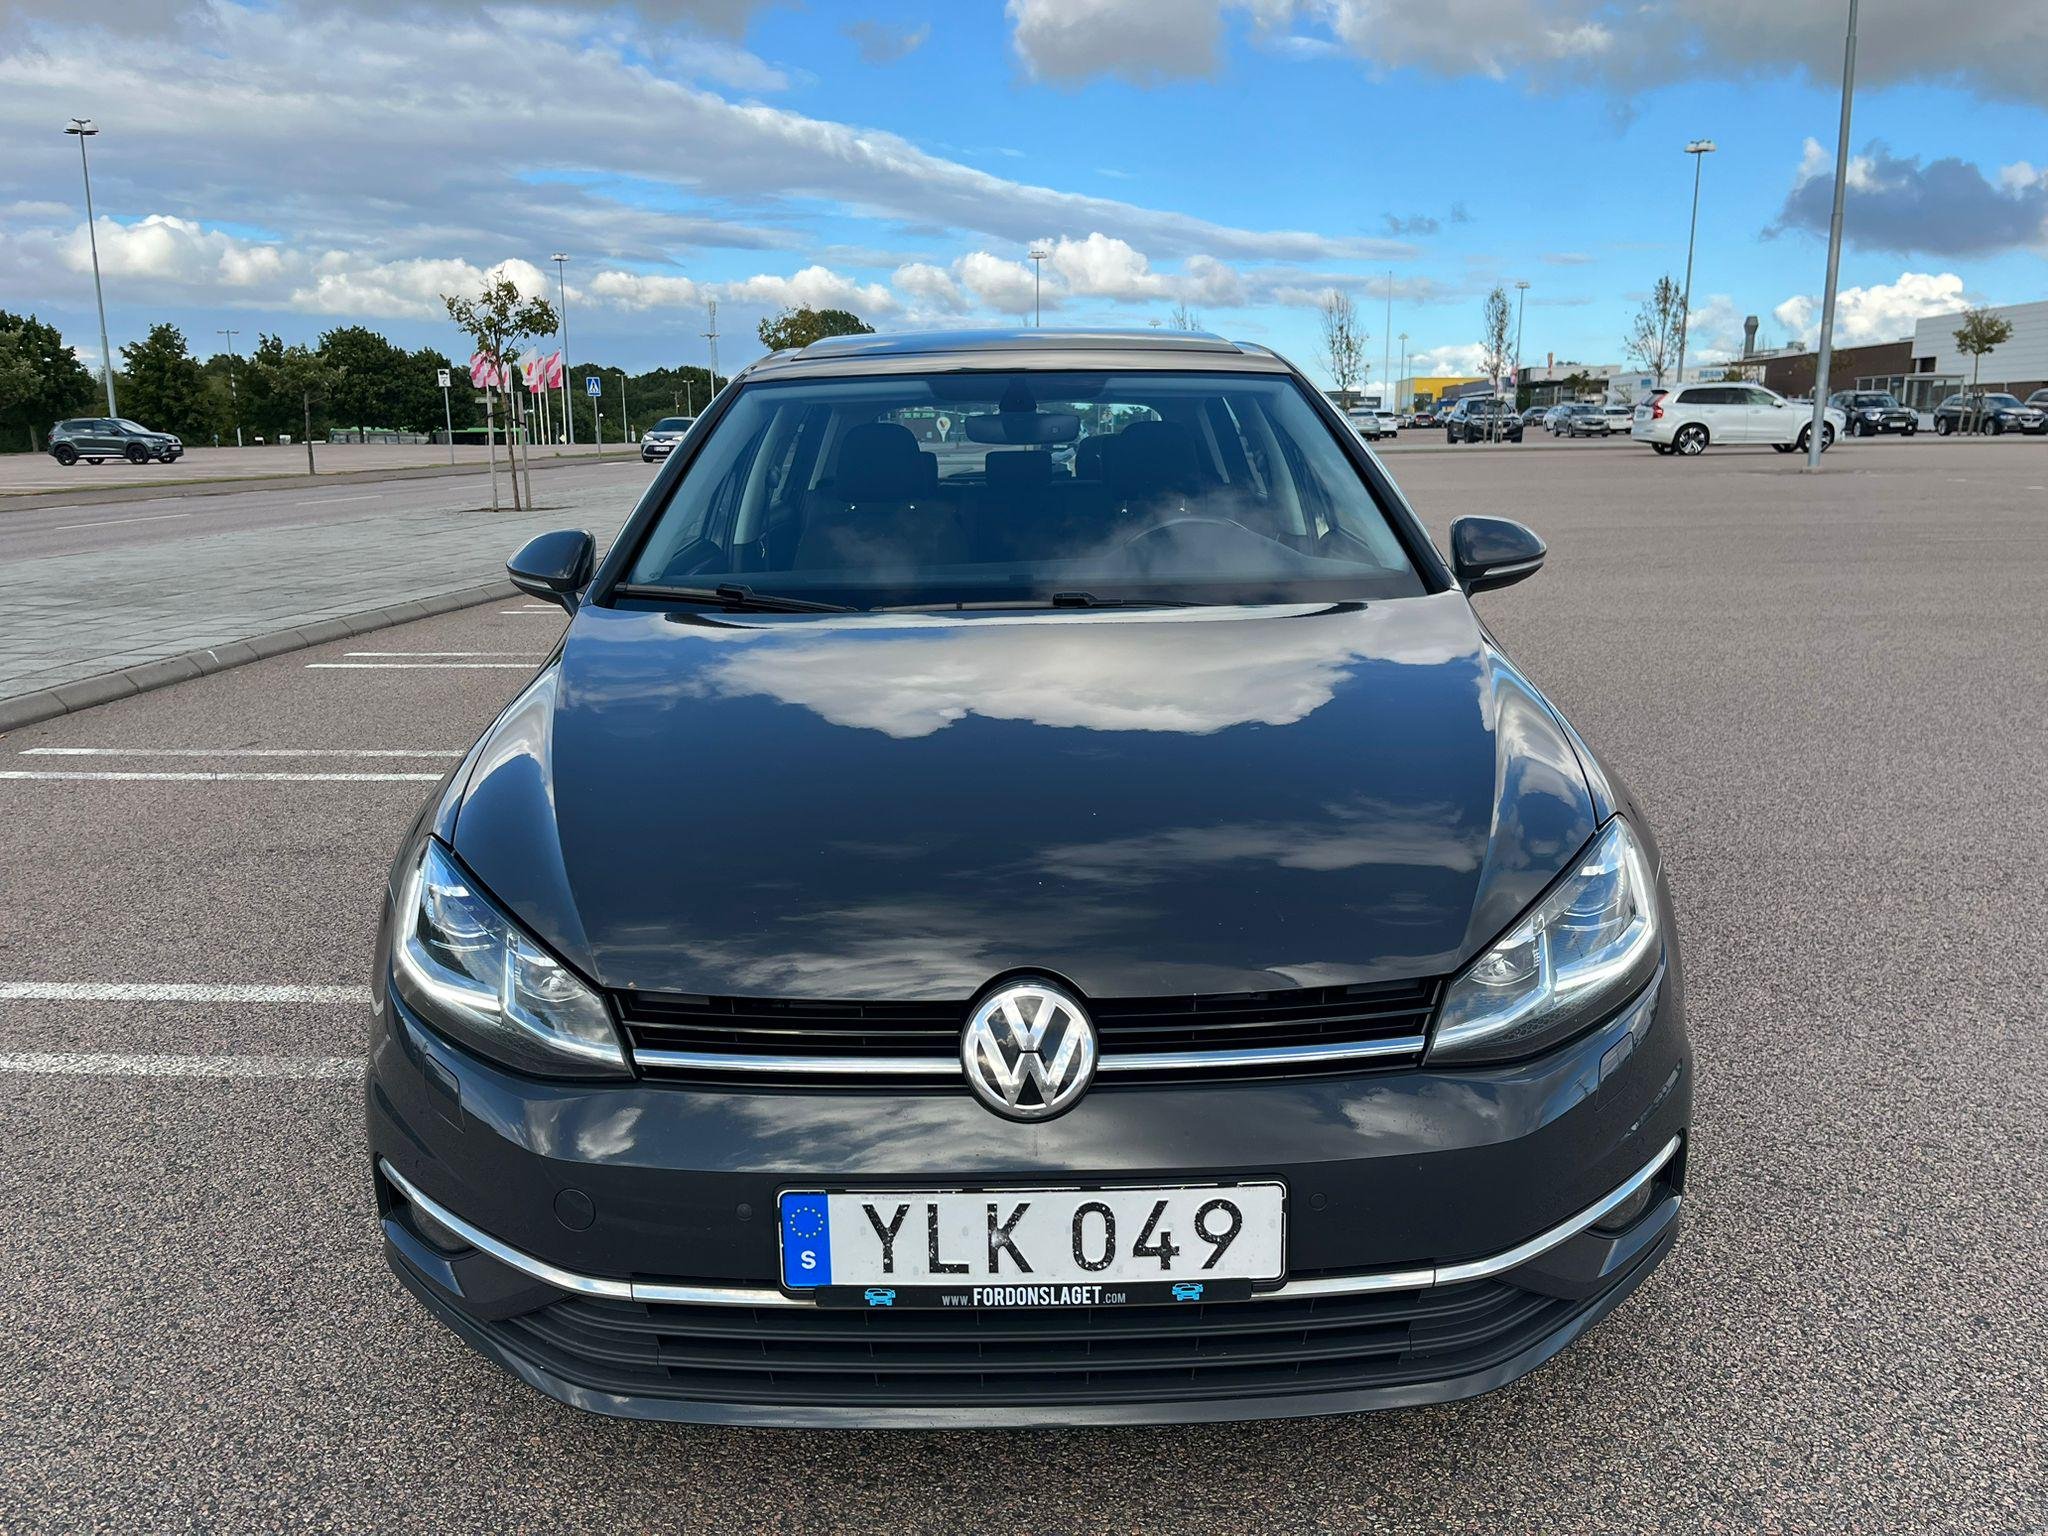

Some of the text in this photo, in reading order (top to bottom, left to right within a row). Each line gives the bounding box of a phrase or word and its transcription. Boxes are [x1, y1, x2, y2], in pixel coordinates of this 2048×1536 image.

[800, 1250, 817, 1270] S
[861, 1199, 1243, 1274] YLK 049
